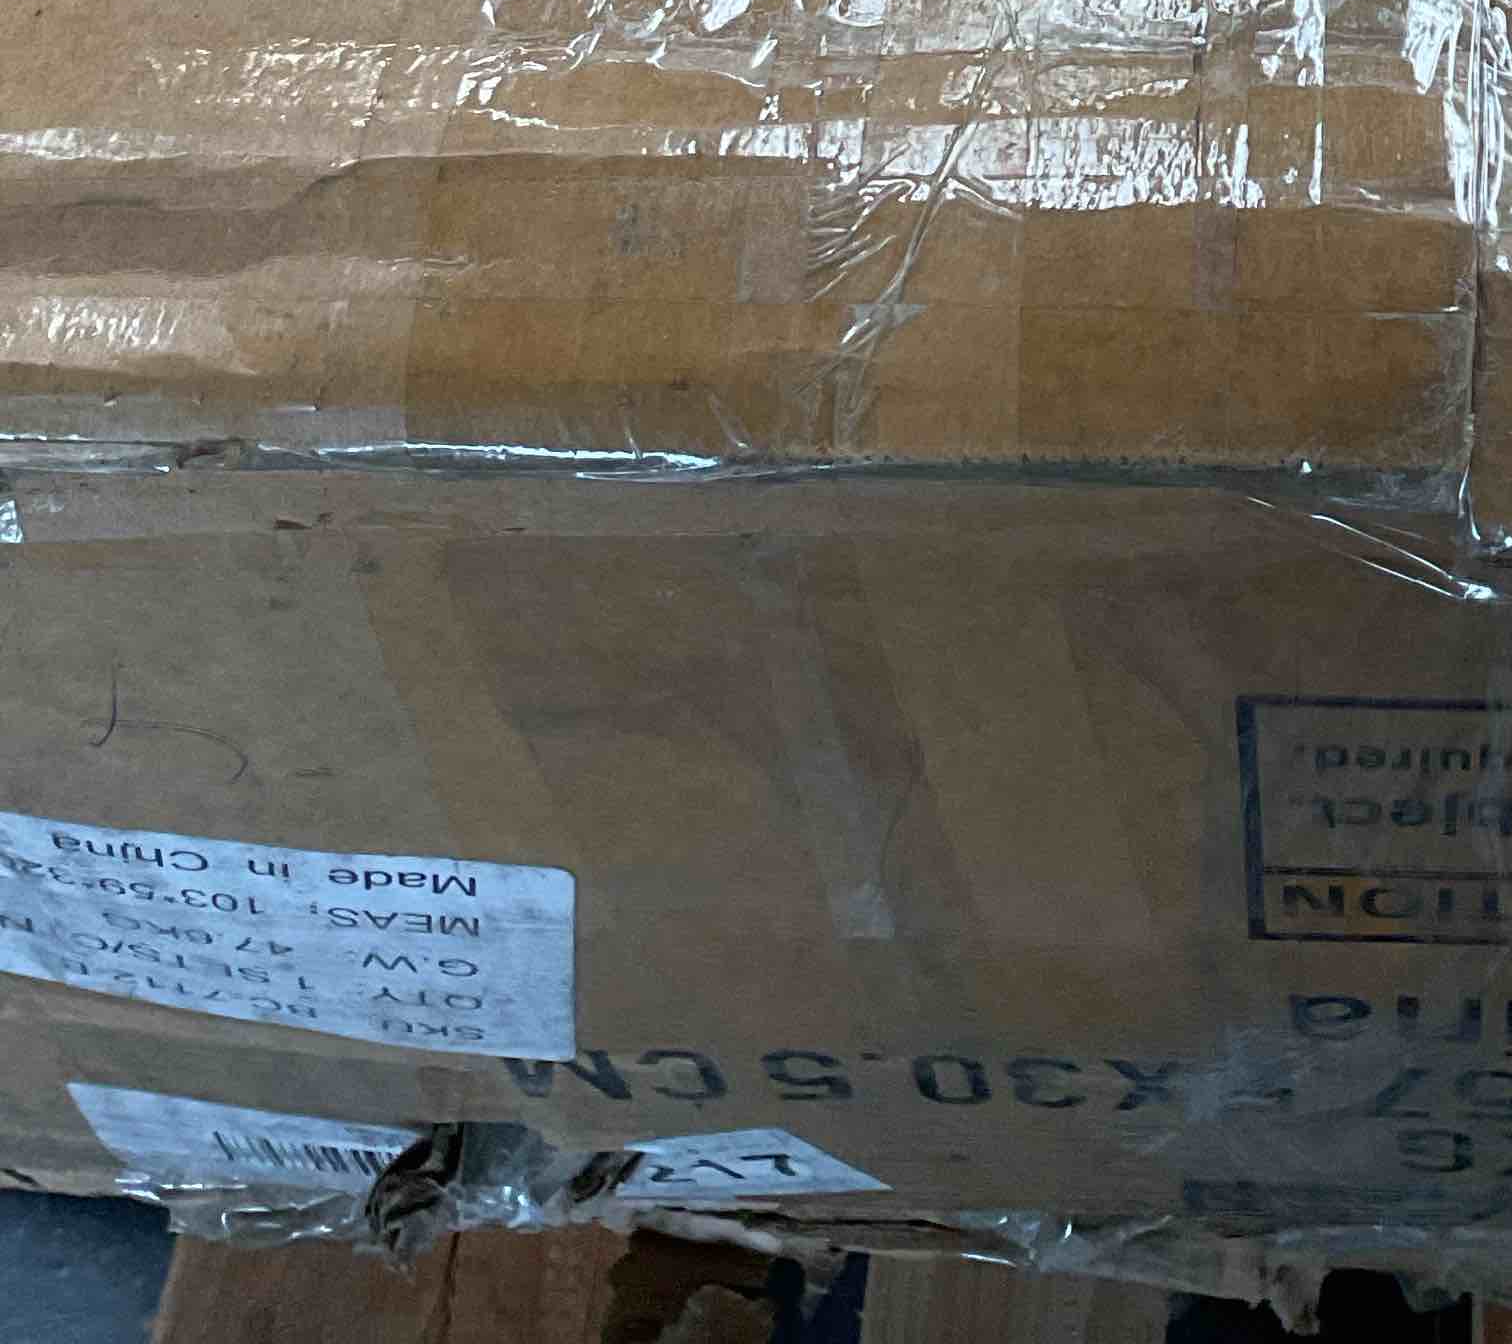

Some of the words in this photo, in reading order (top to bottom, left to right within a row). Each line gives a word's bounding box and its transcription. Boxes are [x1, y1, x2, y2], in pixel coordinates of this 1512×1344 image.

[51, 831, 209, 874] China
[247, 859, 290, 883] in
[327, 868, 478, 897] Made
[502, 1049, 726, 1110] CM
